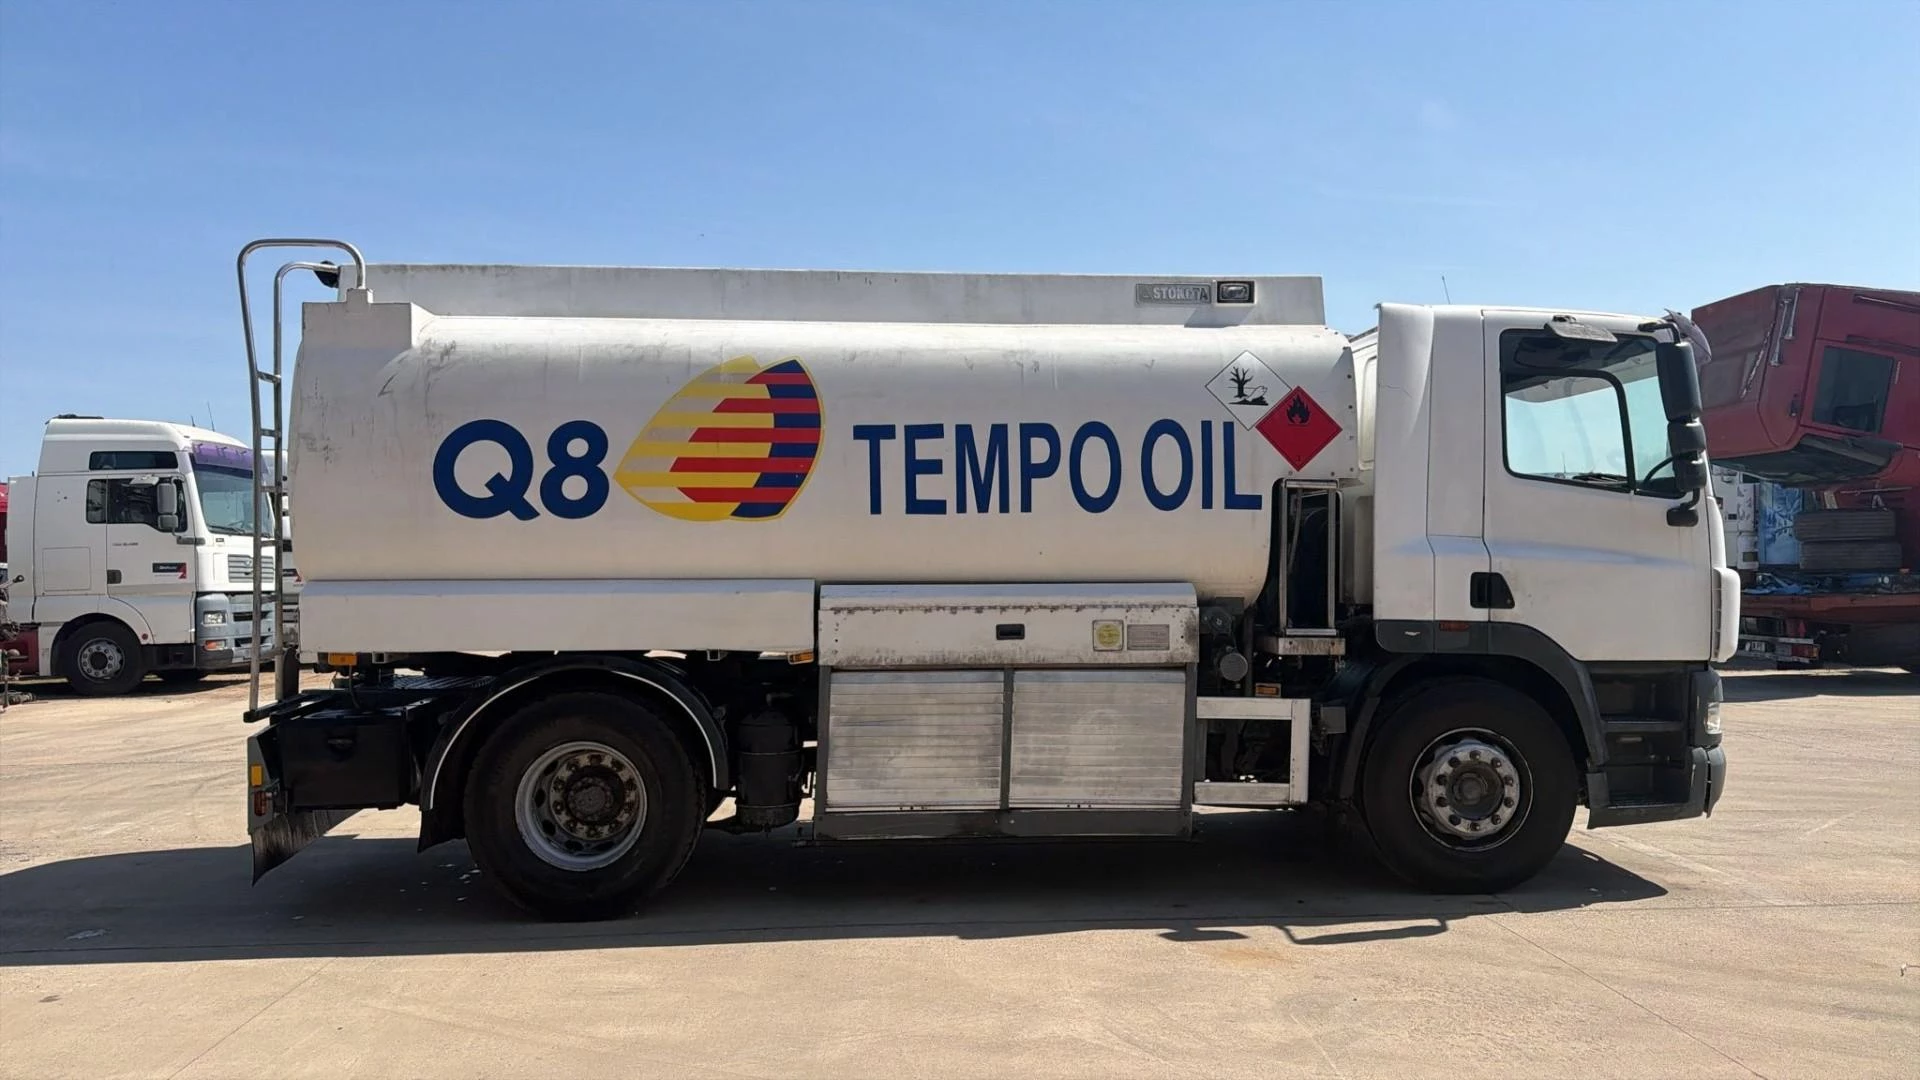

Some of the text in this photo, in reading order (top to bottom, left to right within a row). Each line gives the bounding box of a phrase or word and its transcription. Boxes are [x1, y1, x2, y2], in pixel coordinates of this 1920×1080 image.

[434, 419, 1262, 519] Q8 TEMPO OIL
